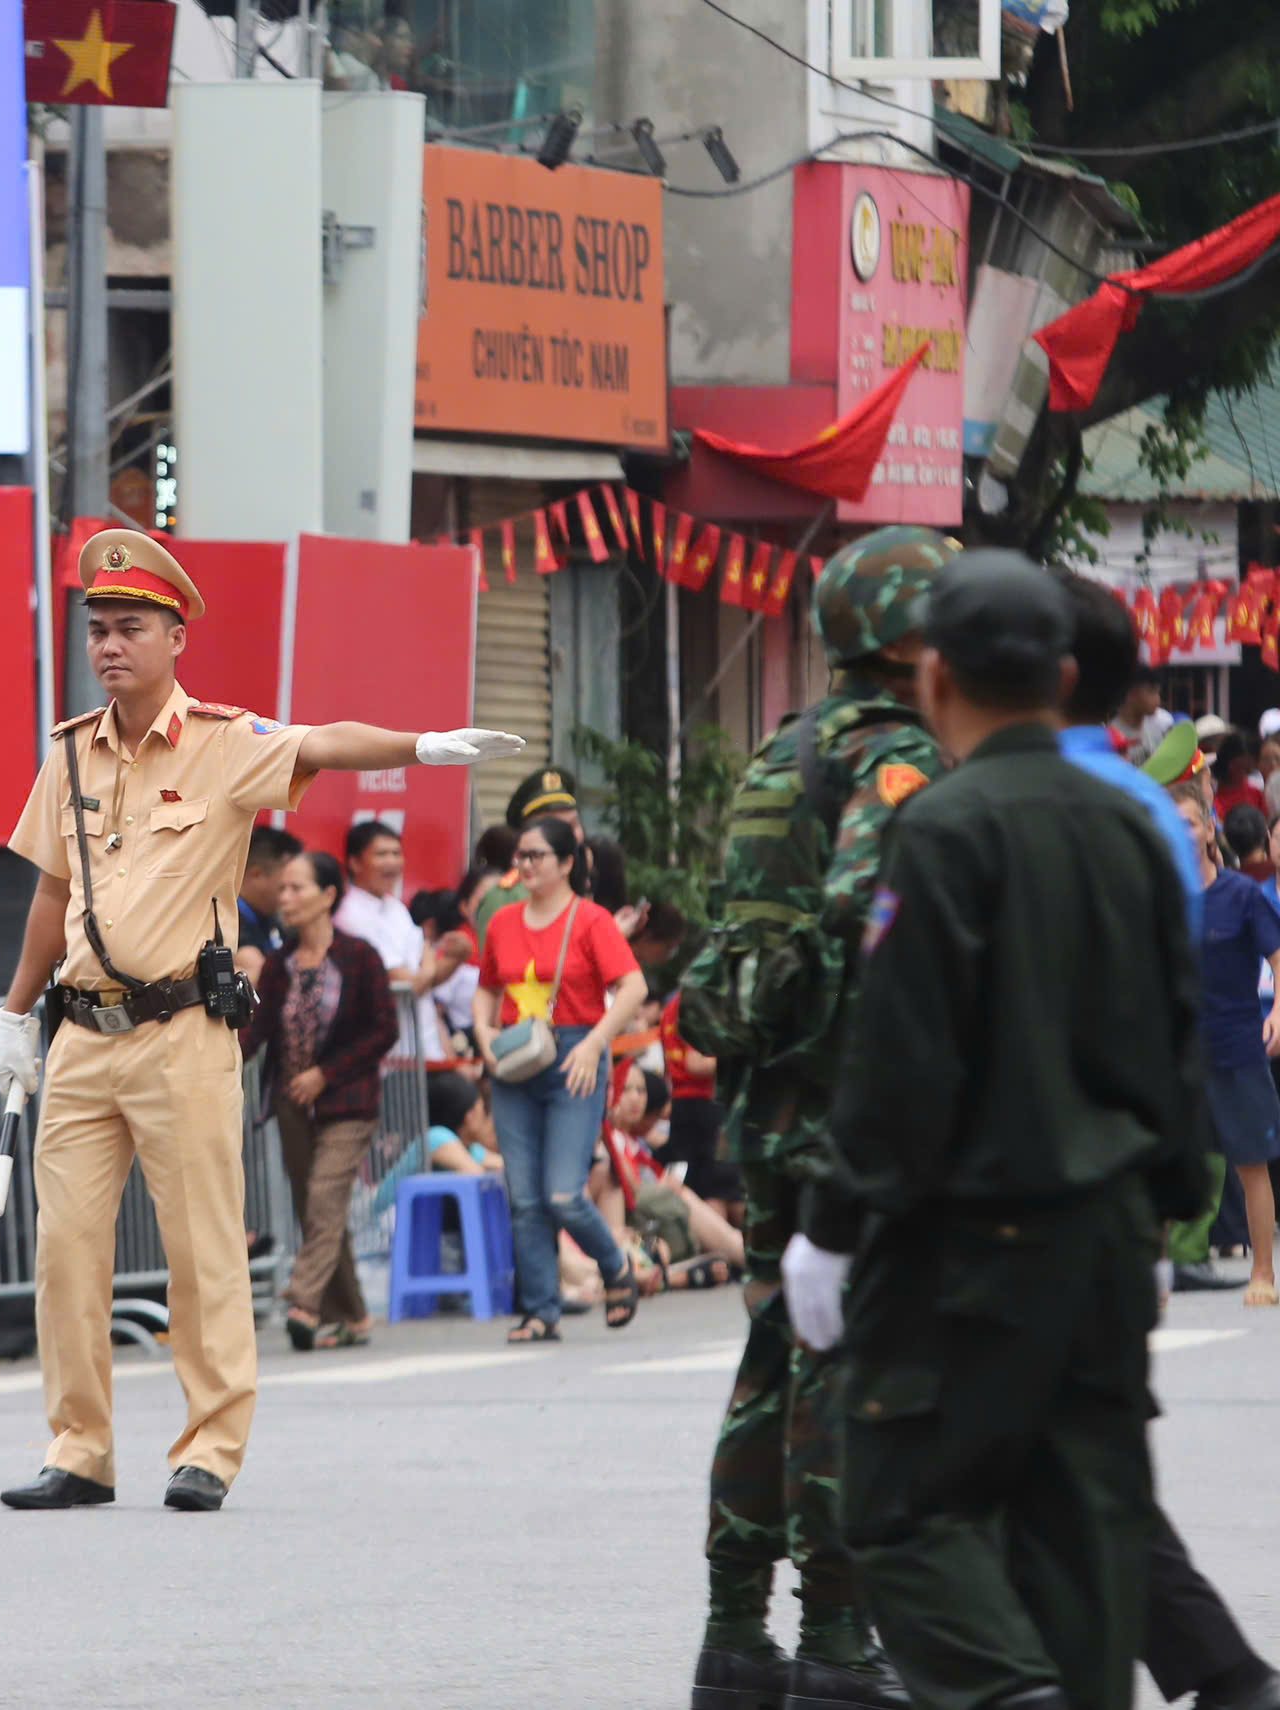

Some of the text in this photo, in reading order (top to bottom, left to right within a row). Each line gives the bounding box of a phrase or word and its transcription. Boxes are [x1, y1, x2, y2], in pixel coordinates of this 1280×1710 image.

[446, 197, 652, 304] BARBER SHOP
[550, 327, 586, 390] TÓC
[589, 341, 630, 393] NAM
